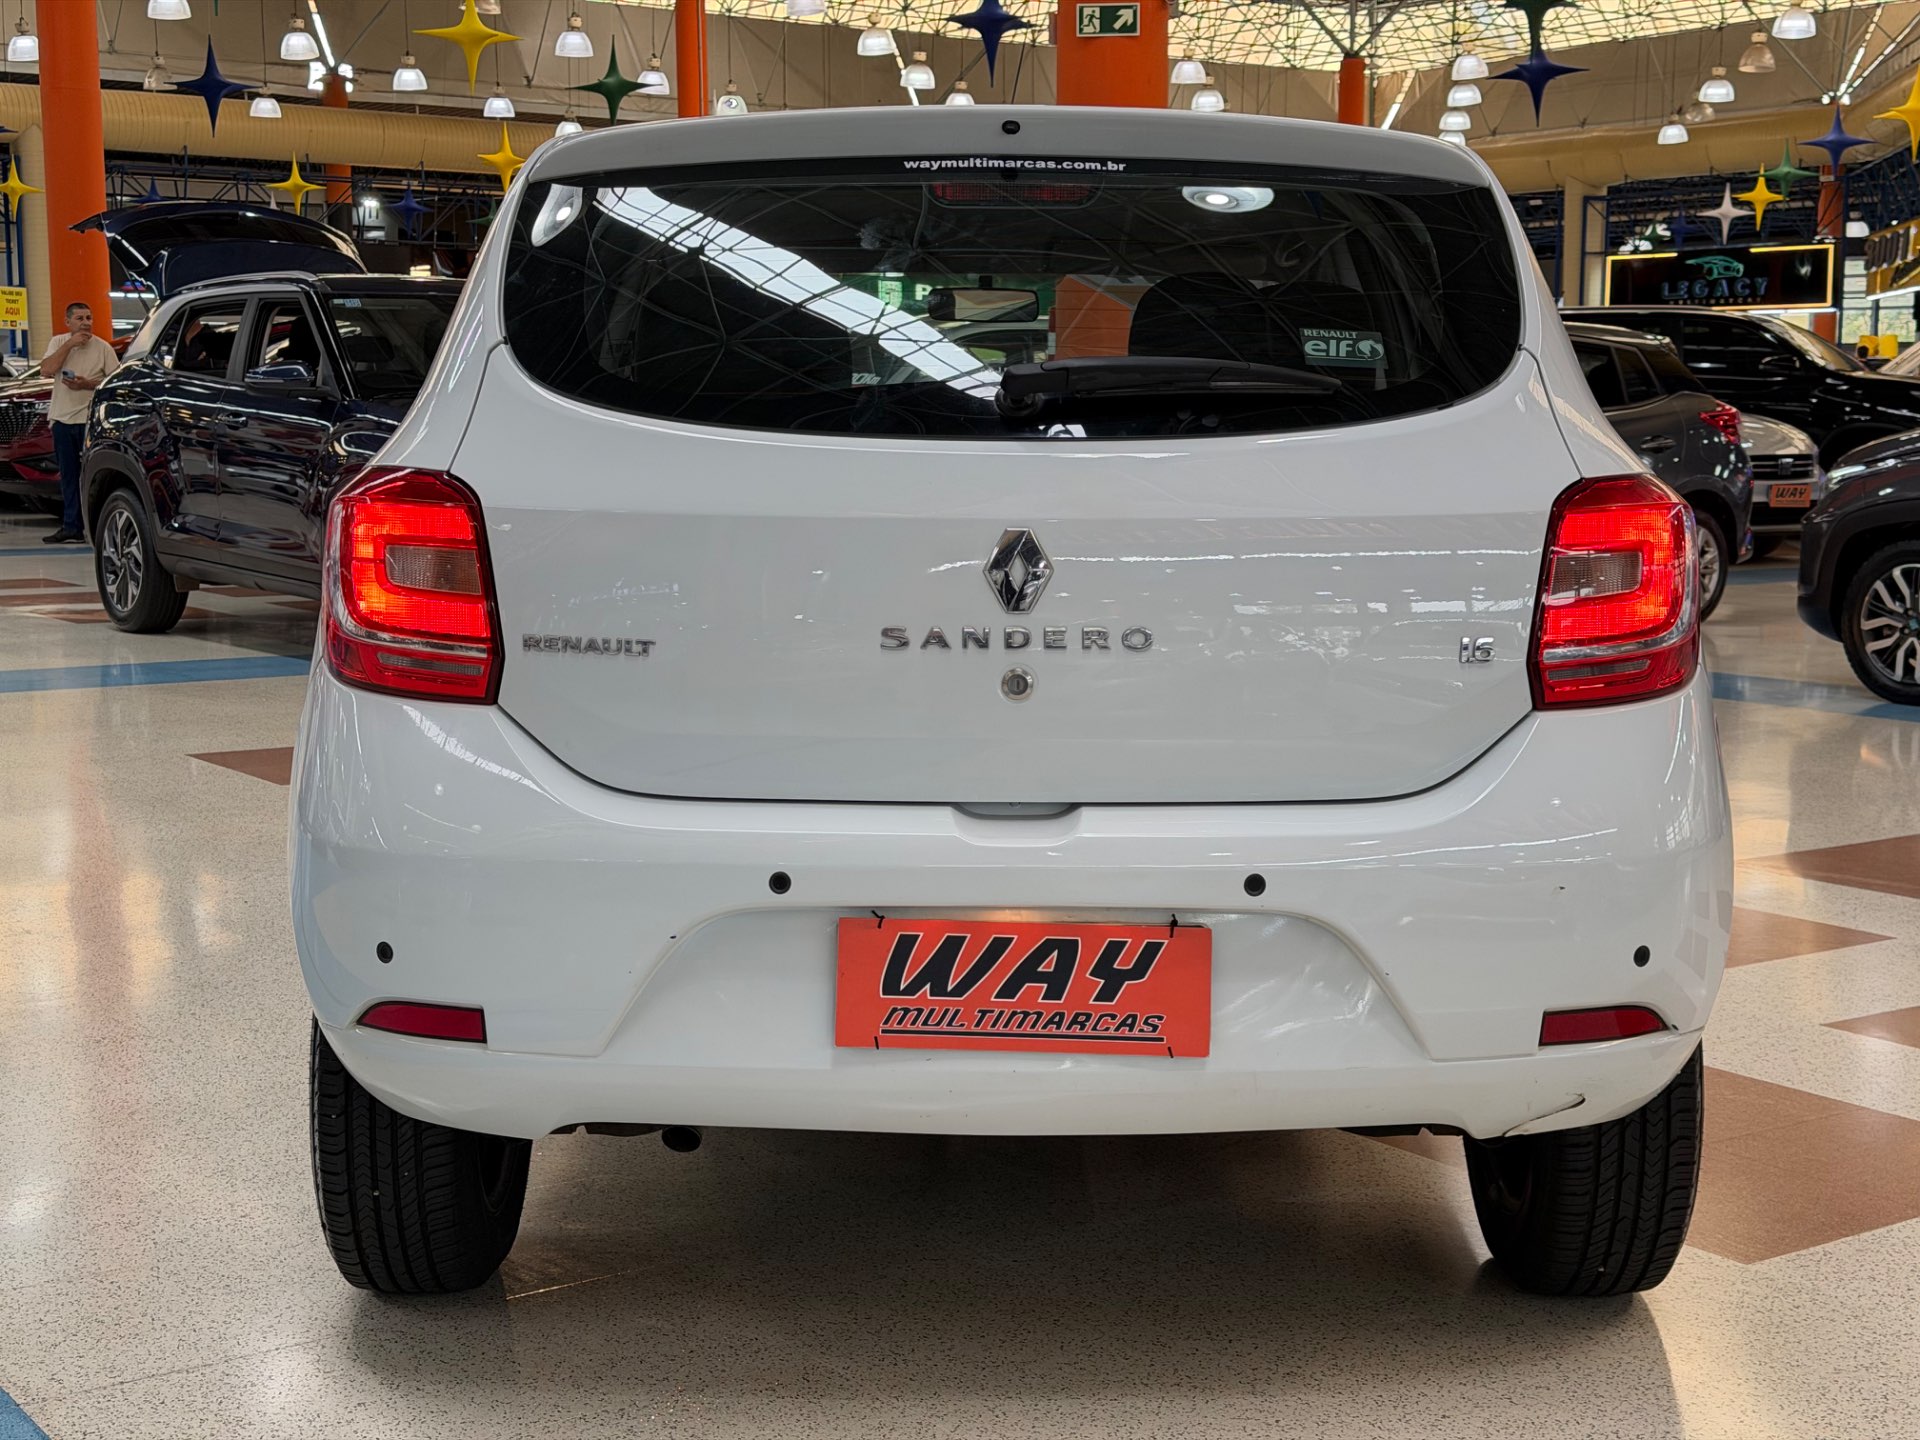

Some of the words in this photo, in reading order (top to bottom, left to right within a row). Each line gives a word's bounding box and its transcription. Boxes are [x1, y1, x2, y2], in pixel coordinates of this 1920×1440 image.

[903, 157, 1127, 171] waymultimarcas.com.br
[1662, 277, 1769, 300] LEGACY
[5, 307, 21, 316] AQUI
[1303, 328, 1358, 339] RENAULT
[1304, 339, 1354, 357] elf
[1776, 487, 1807, 499] WAY
[522, 634, 657, 657] RENAULT
[880, 626, 1154, 652] SANDERO
[880, 932, 1169, 1004] WAY
[880, 1005, 1167, 1034] MULTIMARCAS
